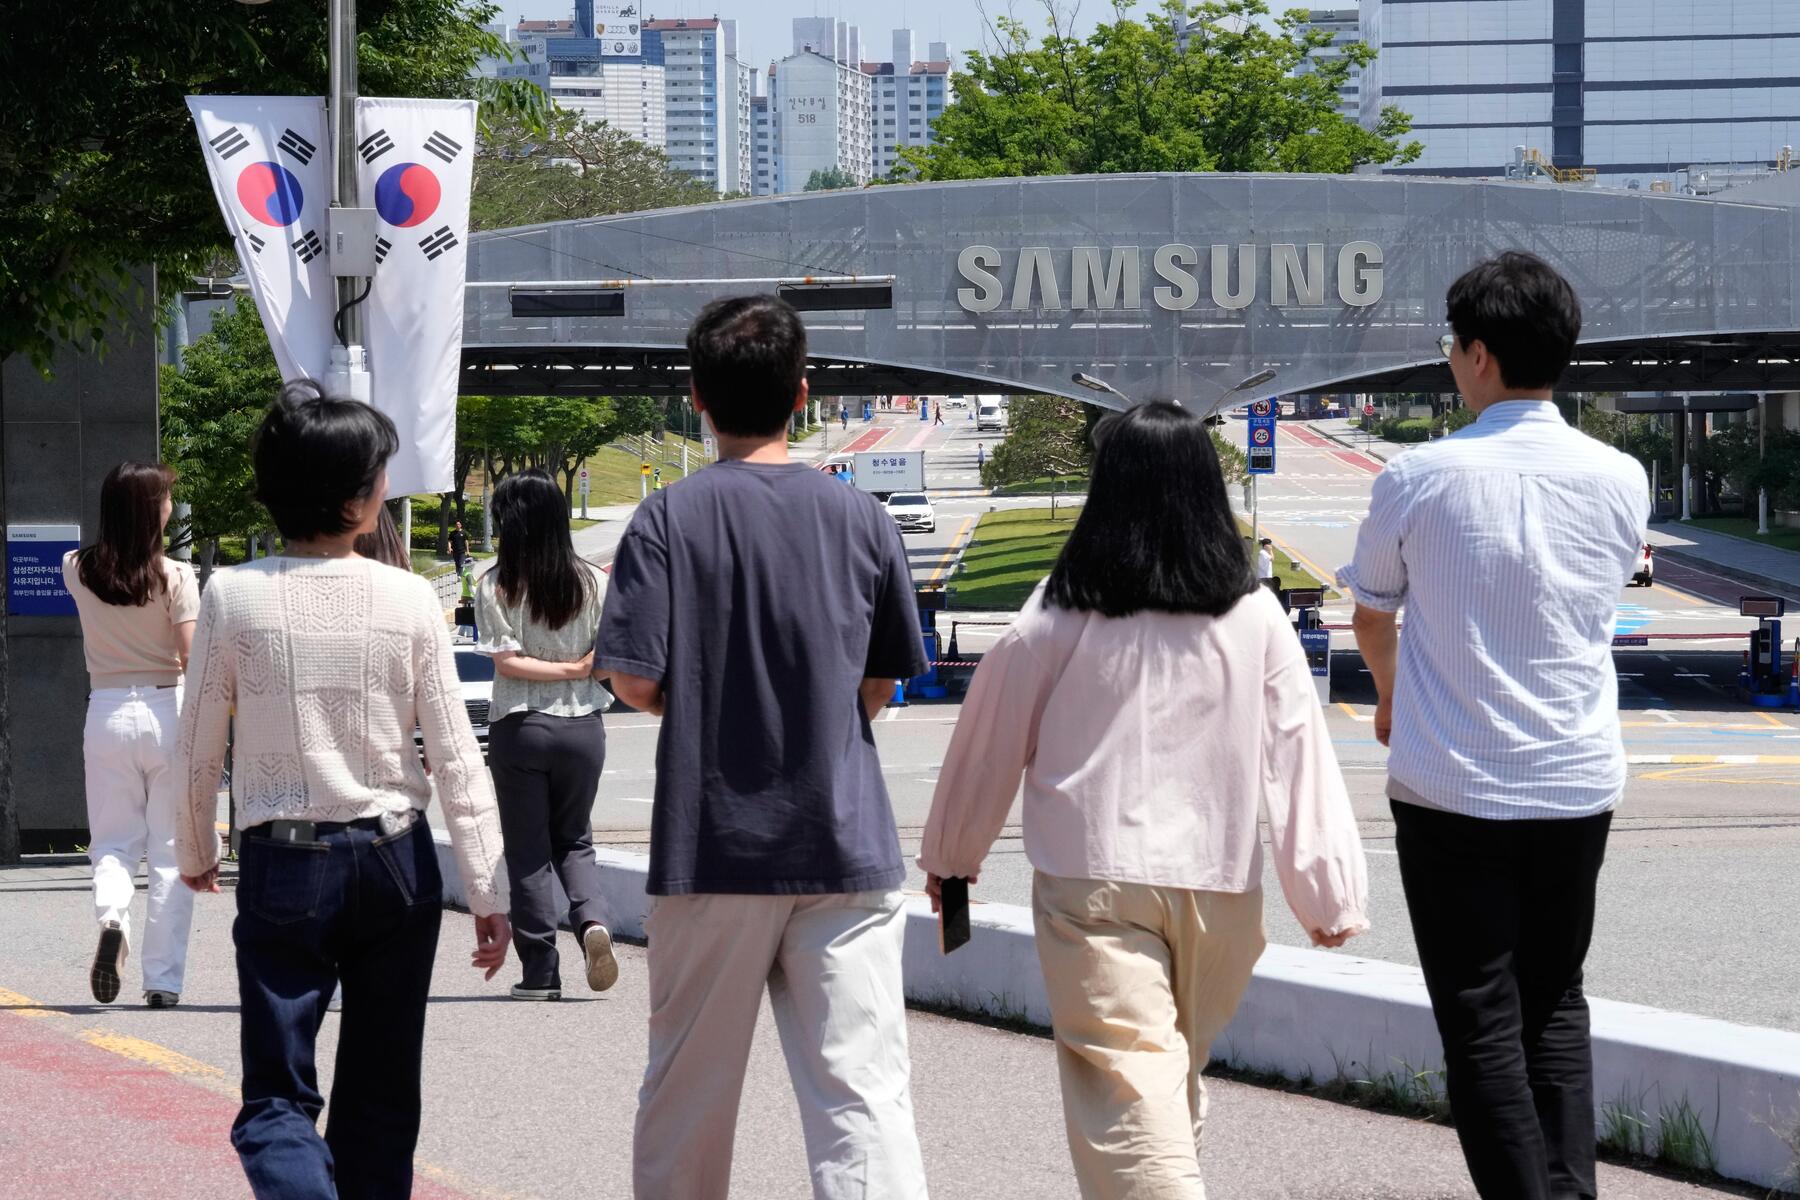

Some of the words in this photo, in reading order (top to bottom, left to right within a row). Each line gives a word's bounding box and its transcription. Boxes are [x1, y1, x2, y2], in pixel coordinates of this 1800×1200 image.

[798, 113, 816, 124] 518
[957, 240, 1385, 313] SAMSUNG
[1256, 431, 1268, 441] 25
[13, 566, 64, 575] 삼성전자주식회
[13, 577, 57, 586] 사유지입니다.
